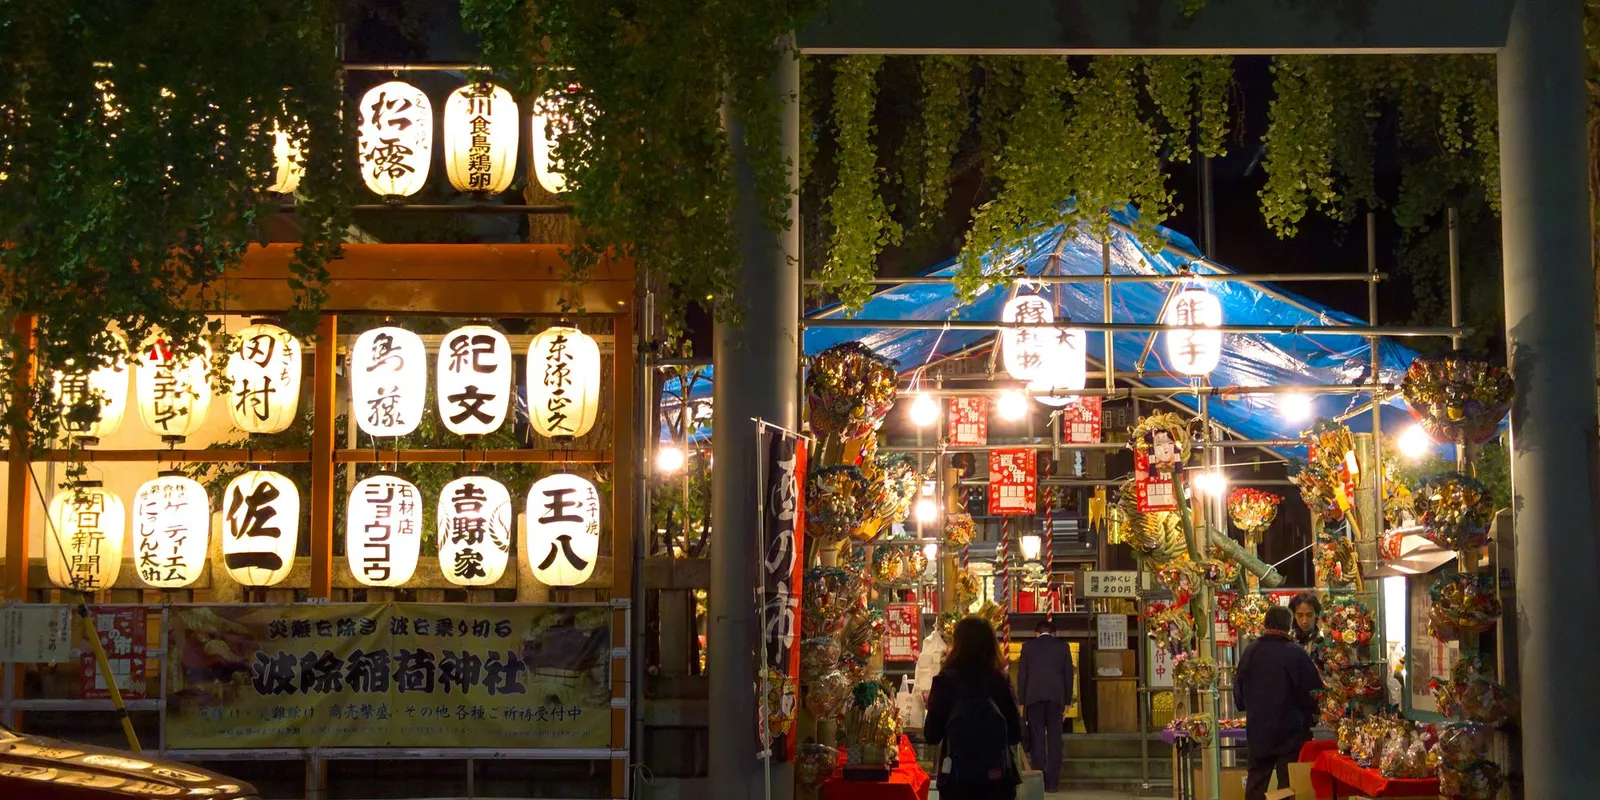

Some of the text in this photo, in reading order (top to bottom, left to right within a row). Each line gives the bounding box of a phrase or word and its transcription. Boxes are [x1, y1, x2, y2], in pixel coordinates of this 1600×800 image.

[371, 91, 415, 180] 松露
[235, 334, 276, 422] 田村
[447, 334, 498, 425] 紀文
[225, 481, 283, 571] 佐一
[363, 483, 396, 582] ジョウコウ
[397, 483, 415, 535] 石材店
[451, 483, 488, 579] 吉野家
[537, 487, 589, 572] 玉八
[1103, 575, 1131, 583] おみくじ
[1103, 585, 1131, 594] 200円
[390, 616, 513, 638] 波を乗り切る
[250, 648, 527, 696] 波除稲荷神社
